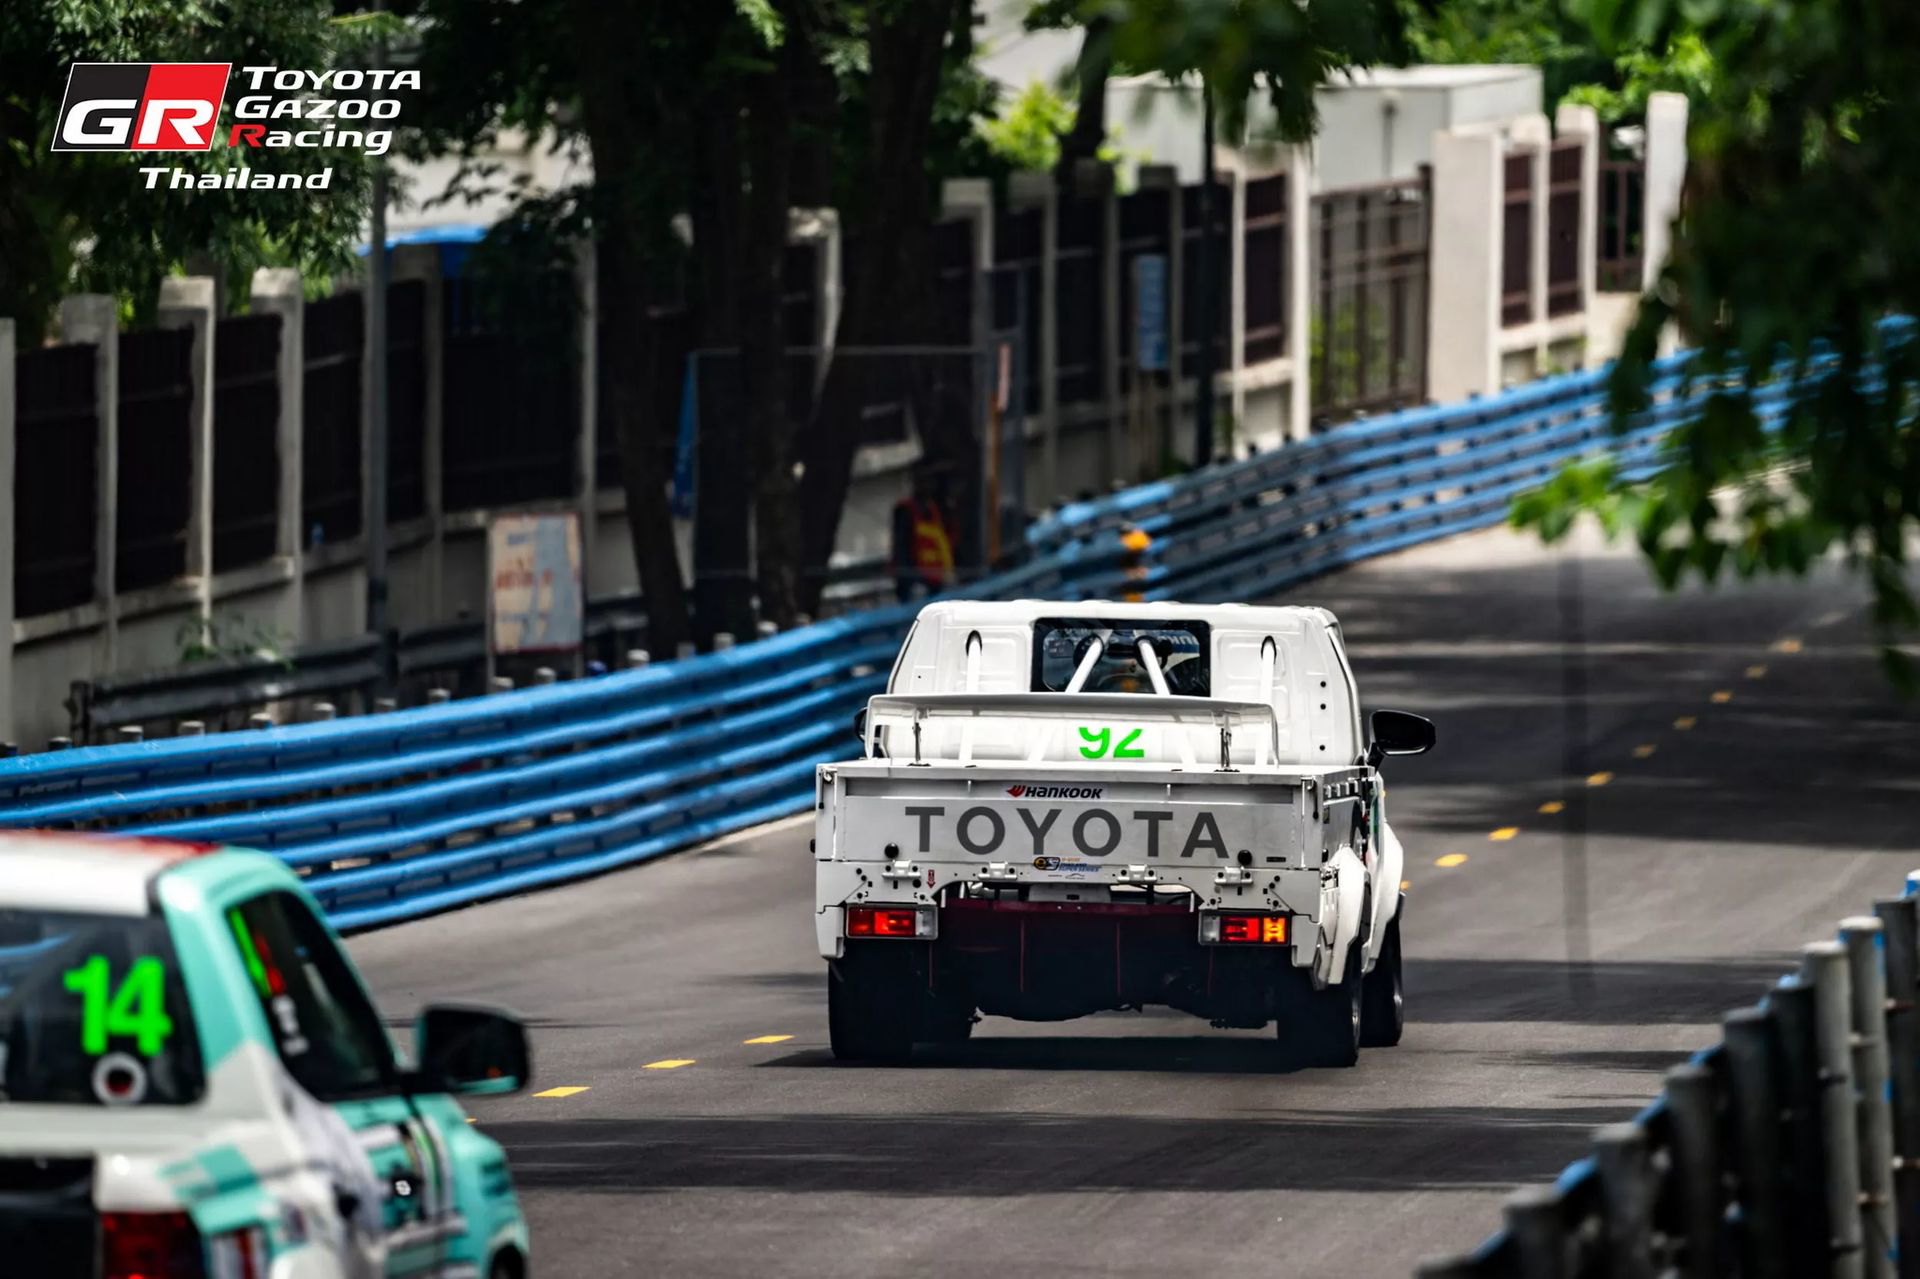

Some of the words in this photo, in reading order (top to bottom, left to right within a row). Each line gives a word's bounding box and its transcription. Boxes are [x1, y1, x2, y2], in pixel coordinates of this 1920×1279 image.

[1078, 727, 1144, 759] 92
[905, 806, 1230, 859] TOYOTA
[64, 955, 173, 1056] 14
